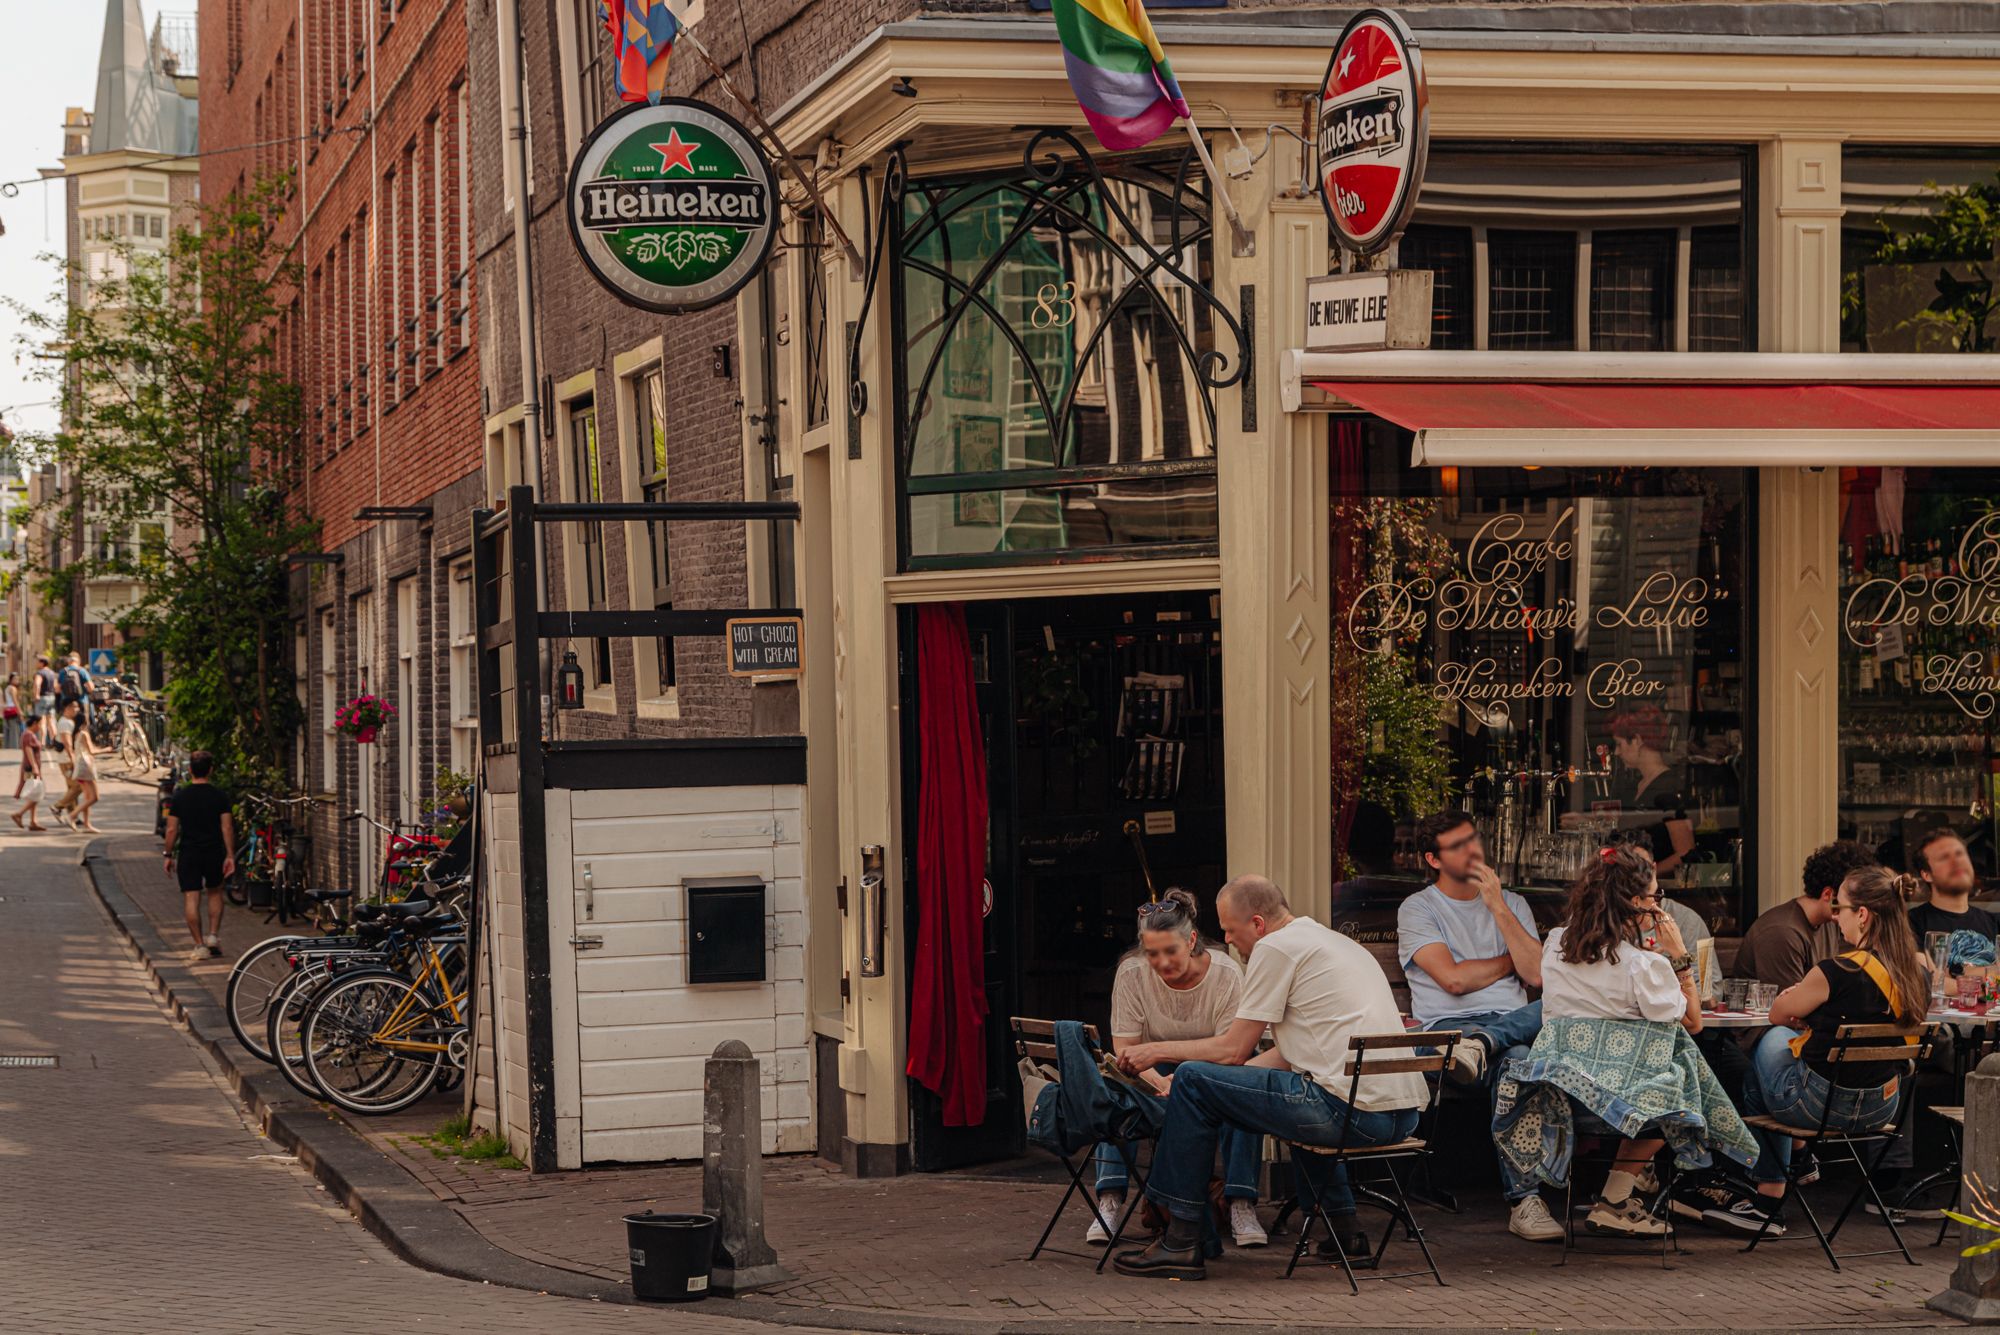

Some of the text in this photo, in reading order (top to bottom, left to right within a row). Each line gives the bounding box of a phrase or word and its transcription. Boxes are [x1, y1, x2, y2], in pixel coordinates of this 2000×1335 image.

[1320, 109, 1395, 156] eineken
[589, 185, 760, 219] Heineken
[1334, 182, 1365, 219] bier
[1031, 281, 1078, 328] 83
[1310, 295, 1387, 327] DE NIEUWE LELIE
[1437, 579, 1582, 639] Nieuwe
[733, 625, 796, 643] HOT CHOCO
[734, 647, 797, 663] WITH CREAM
[1433, 658, 1665, 727] Heineken Bier
